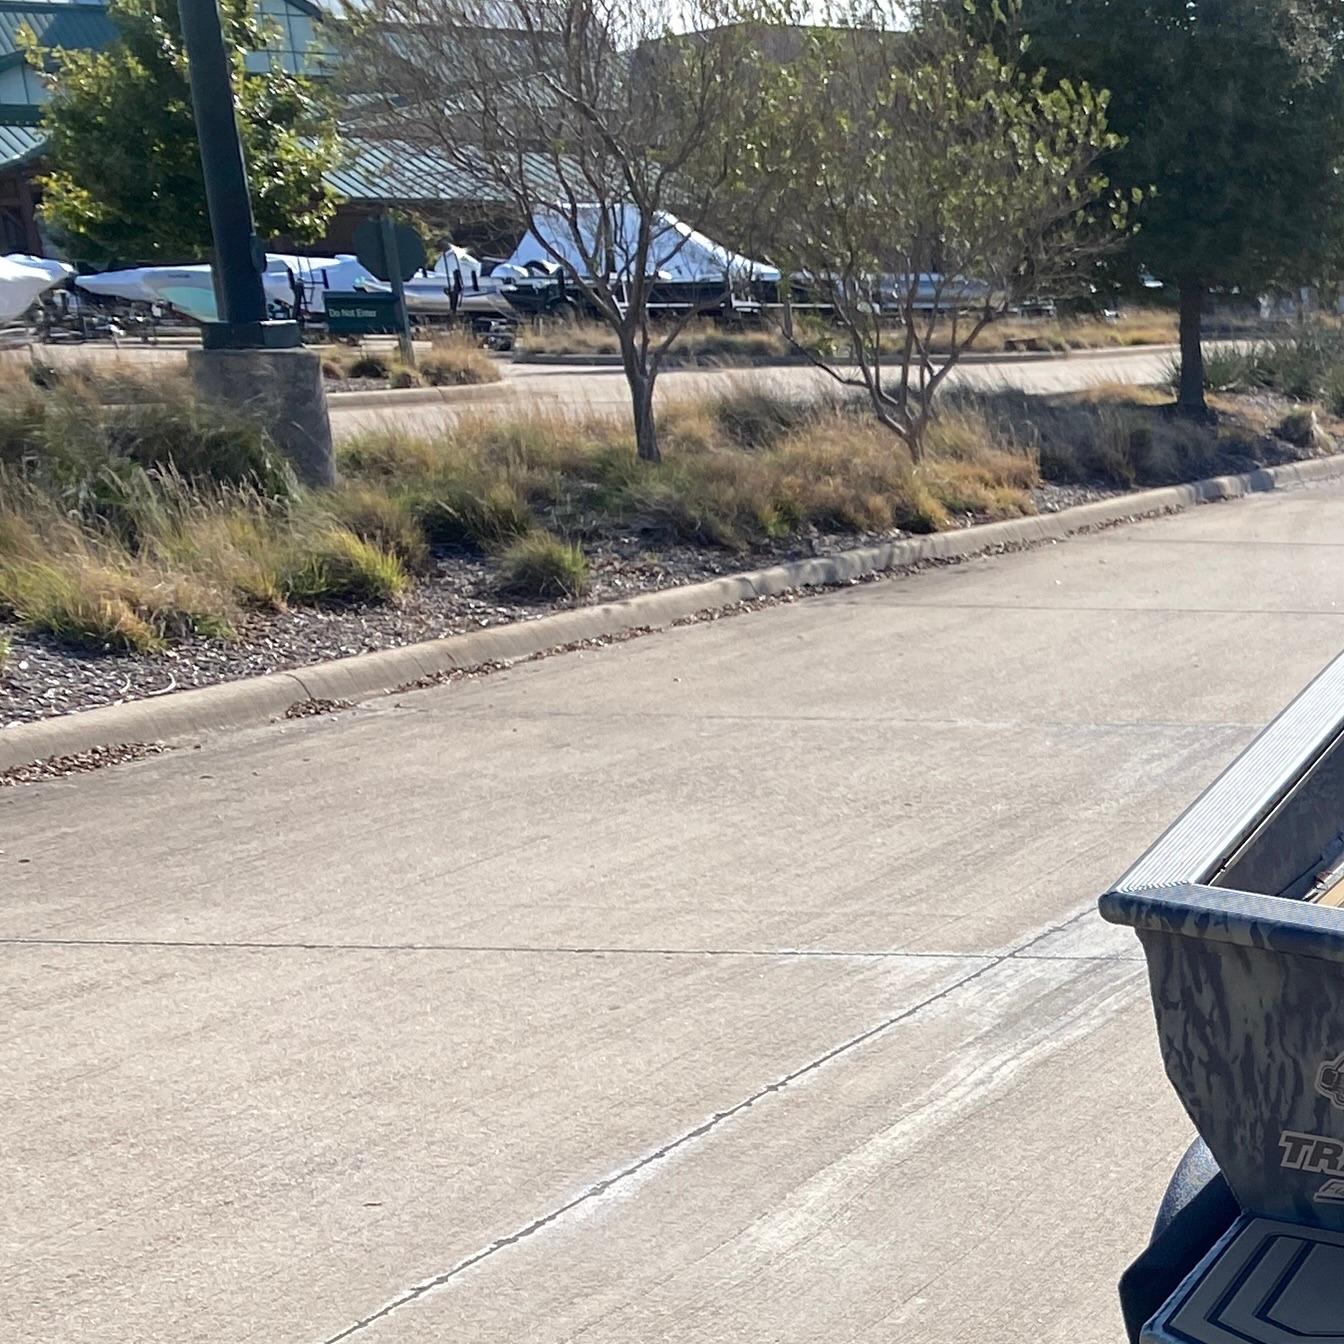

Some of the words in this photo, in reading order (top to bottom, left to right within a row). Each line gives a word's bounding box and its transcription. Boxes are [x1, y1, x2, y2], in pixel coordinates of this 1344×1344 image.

[328, 308, 341, 318] Do
[341, 308, 355, 318] Not
[356, 308, 377, 318] Enter
